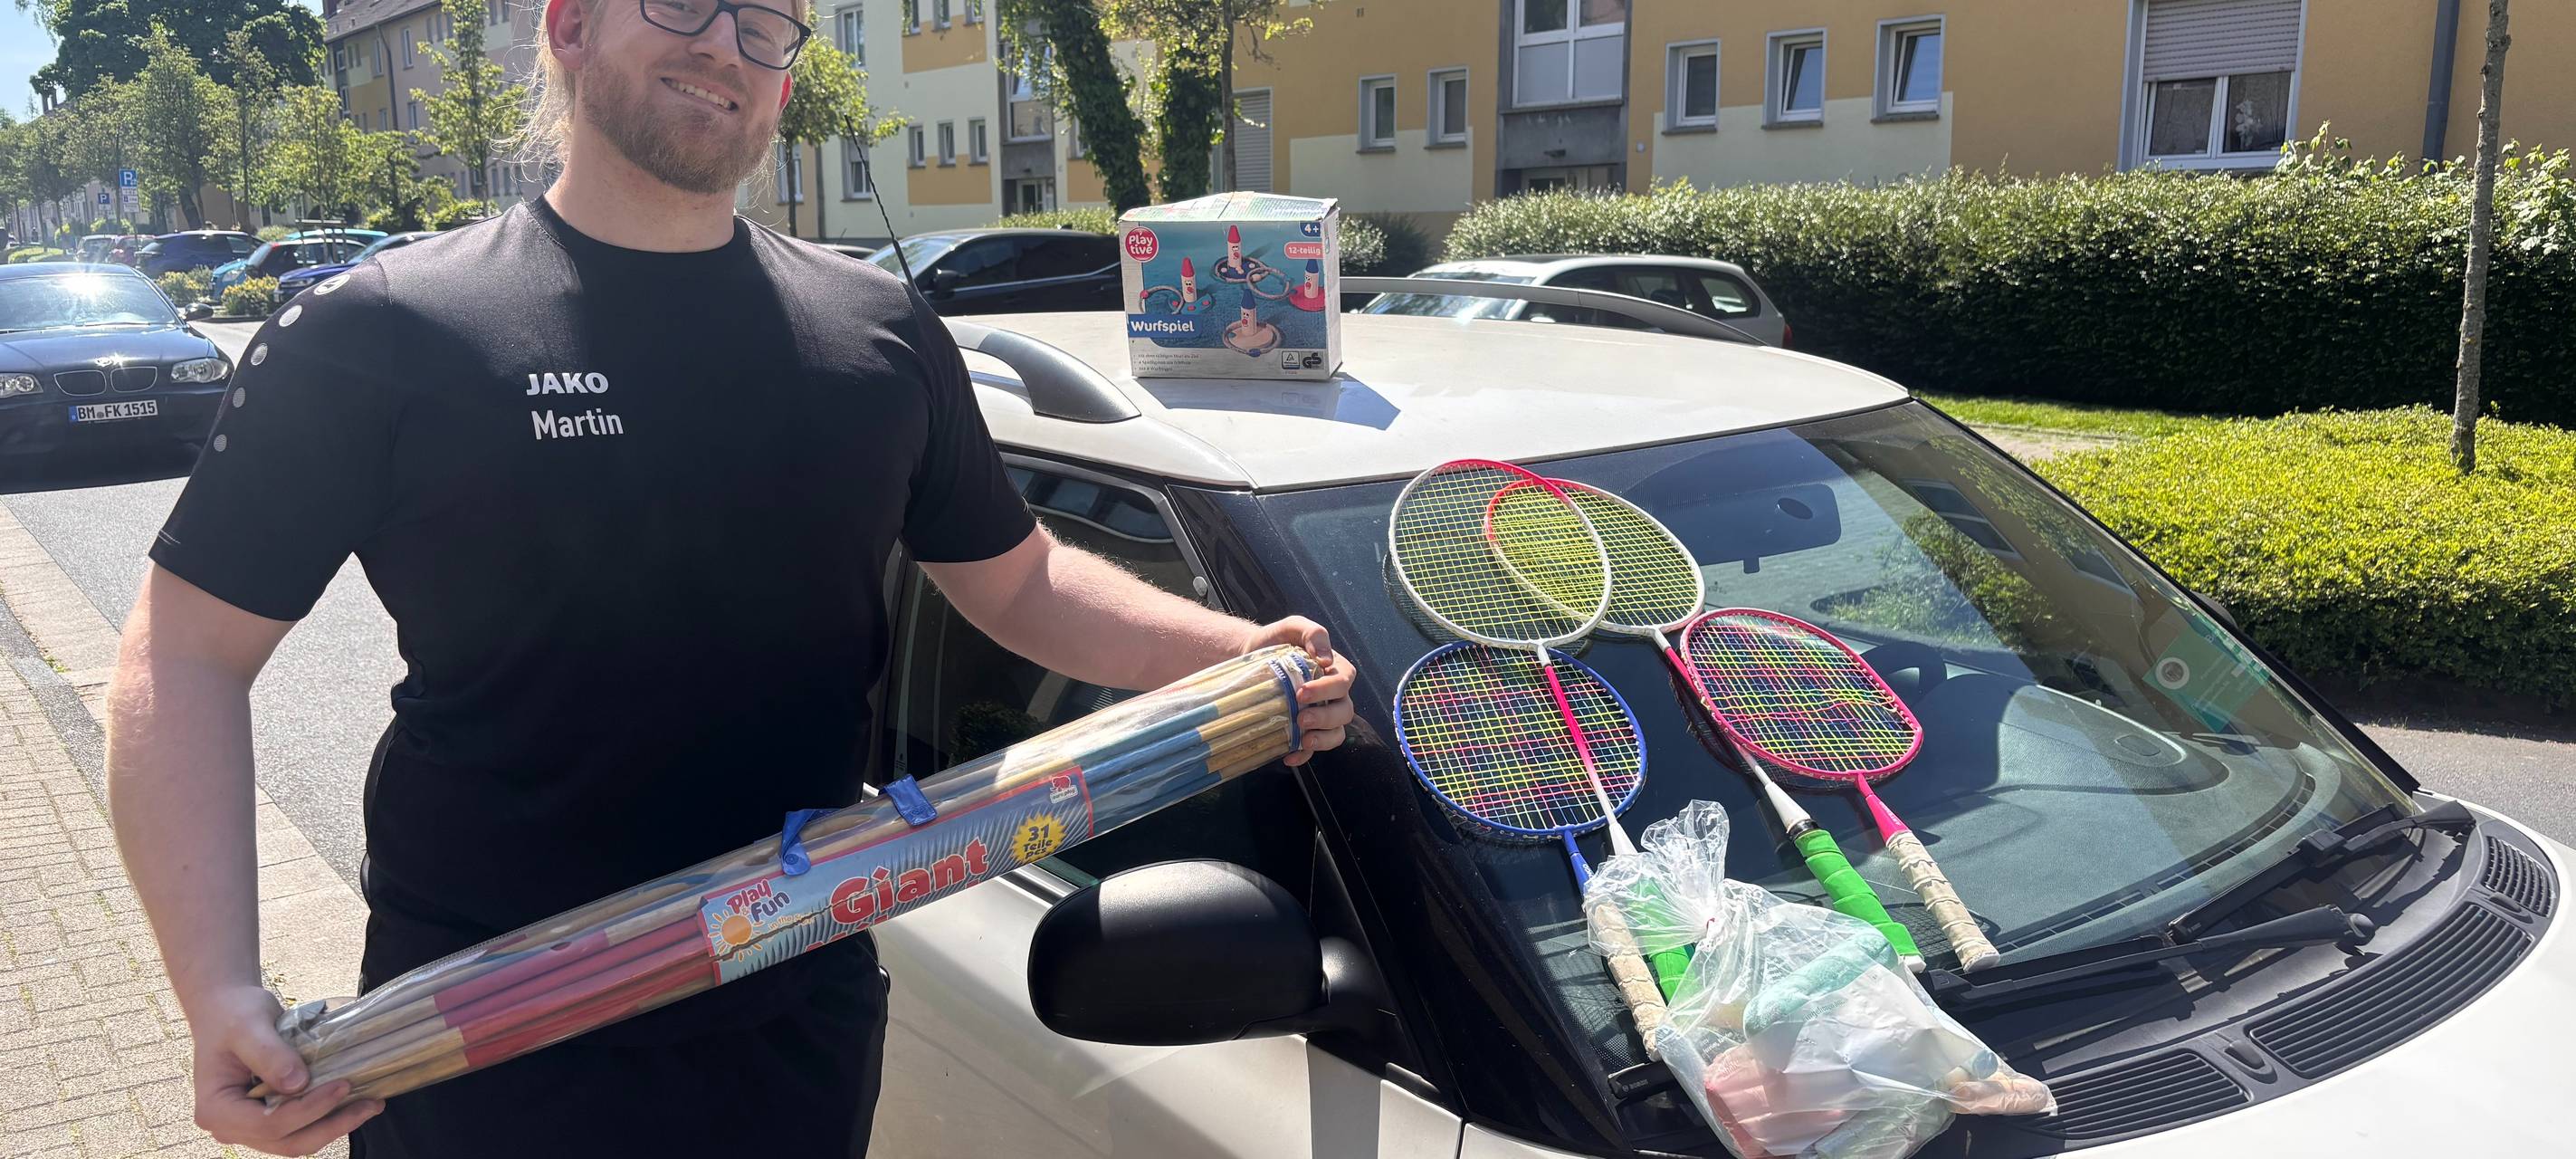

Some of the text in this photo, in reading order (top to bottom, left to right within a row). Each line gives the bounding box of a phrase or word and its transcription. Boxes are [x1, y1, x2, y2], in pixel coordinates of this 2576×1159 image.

[123, 171, 133, 185] P
[100, 194, 107, 204] P
[1304, 224, 1319, 234] 4+
[1128, 233, 1153, 248] Play
[1130, 244, 1153, 254] tive
[1288, 245, 1321, 255] 12-teilig
[1131, 320, 1195, 333] Wurfspiel
[526, 372, 609, 396] JAKO
[77, 401, 156, 419] BM FK 1515
[530, 407, 624, 440] Martin
[1028, 824, 1051, 841] 31
[1023, 838, 1053, 852] Teile
[830, 837, 988, 924] Giant
[726, 878, 772, 915] Play
[750, 891, 792, 924] Fun
